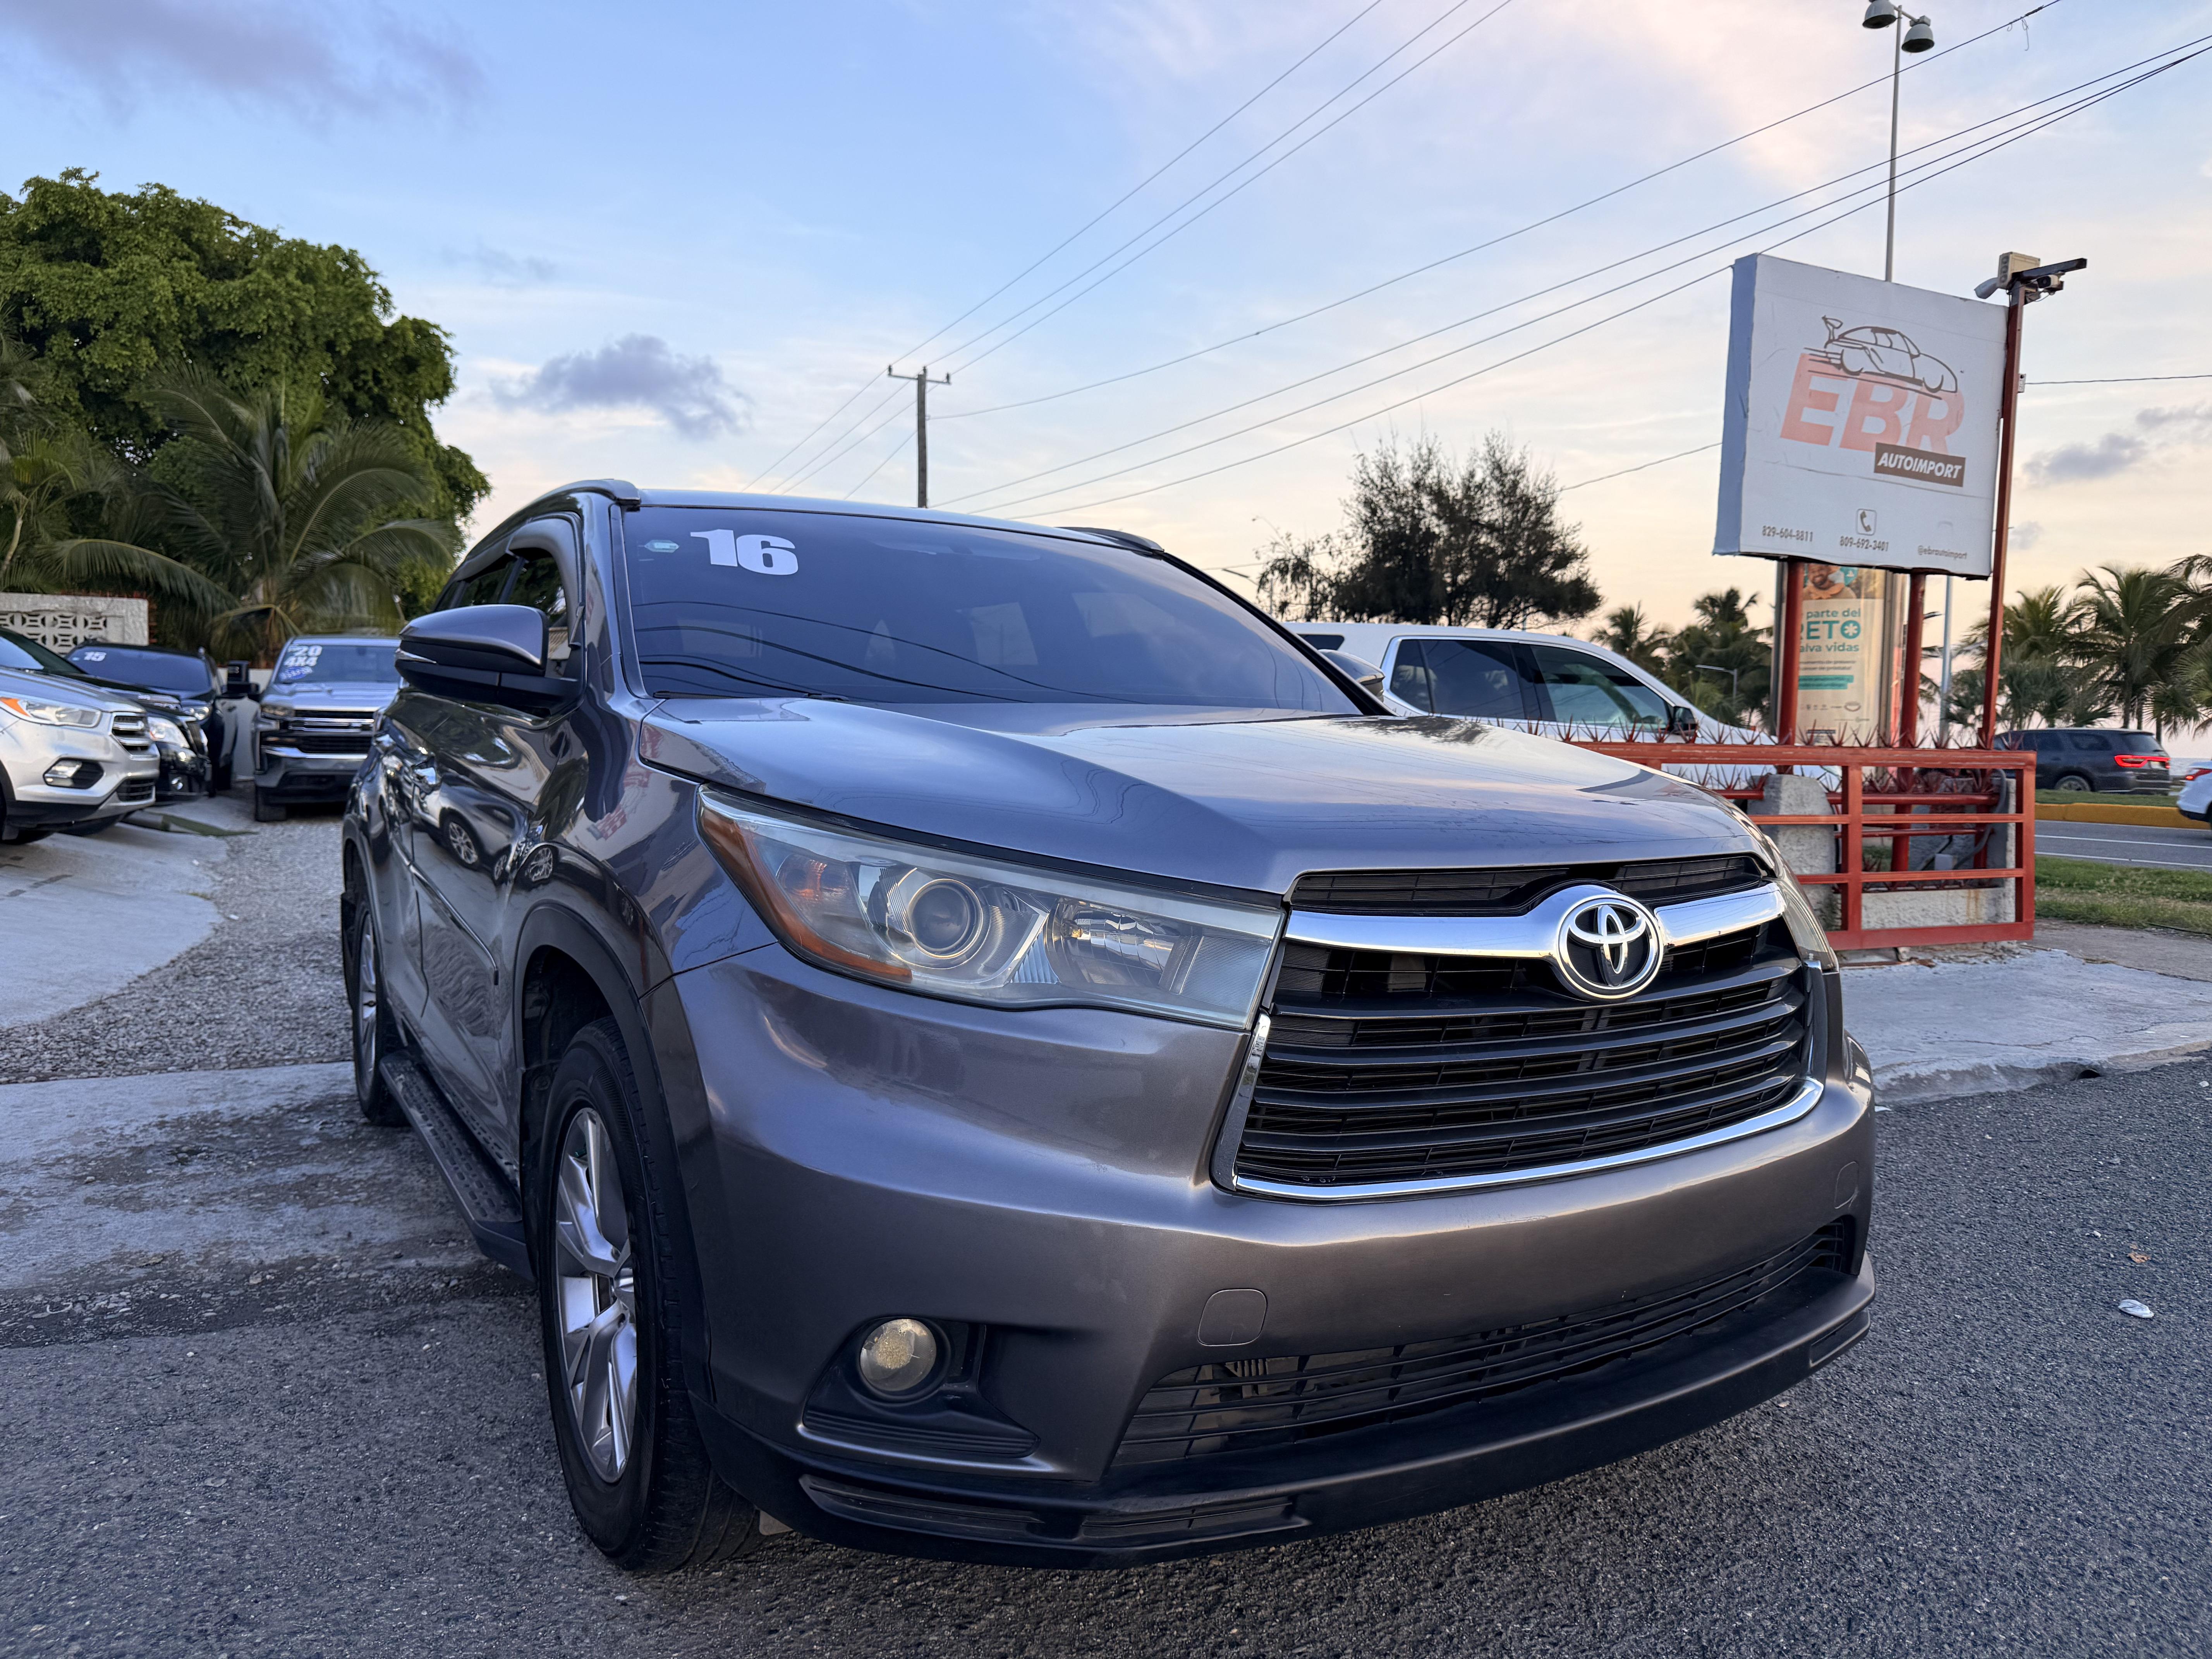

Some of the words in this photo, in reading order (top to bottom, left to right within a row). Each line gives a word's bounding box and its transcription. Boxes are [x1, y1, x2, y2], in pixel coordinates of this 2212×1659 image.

[1780, 353, 1965, 455] EBR
[1878, 452, 1962, 479] AUTOIMPORT
[1762, 525, 1814, 542] 829-604-8811
[690, 529, 799, 575] 16
[1840, 536, 1889, 552] 809-692-3401
[1918, 545, 1967, 559] @ebrautoimport
[1807, 609, 1838, 620] parte
[1842, 608, 1860, 617] del
[1800, 644, 1822, 652] alva
[1826, 642, 1859, 652] vidas
[84, 652, 106, 661] 15
